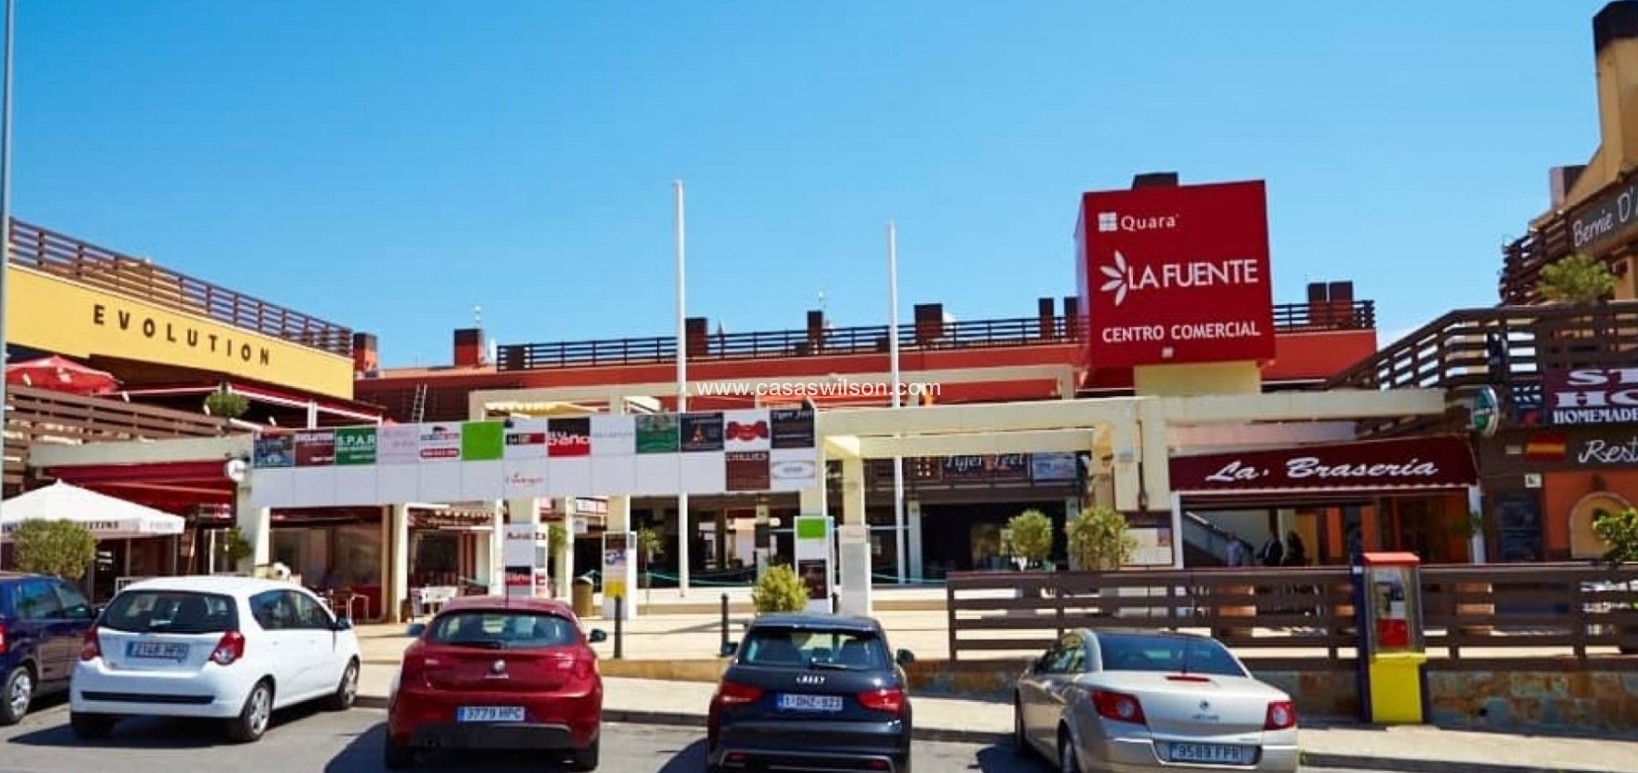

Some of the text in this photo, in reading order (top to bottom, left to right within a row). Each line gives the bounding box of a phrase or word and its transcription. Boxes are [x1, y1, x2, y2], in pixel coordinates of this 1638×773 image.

[1120, 216, 1176, 232] Quara
[1573, 208, 1614, 247] Bernie
[1128, 259, 1259, 290] LA FUENTE
[93, 304, 271, 366] EVOLUTION
[1102, 322, 1261, 343] CENTRO COMERCIAL
